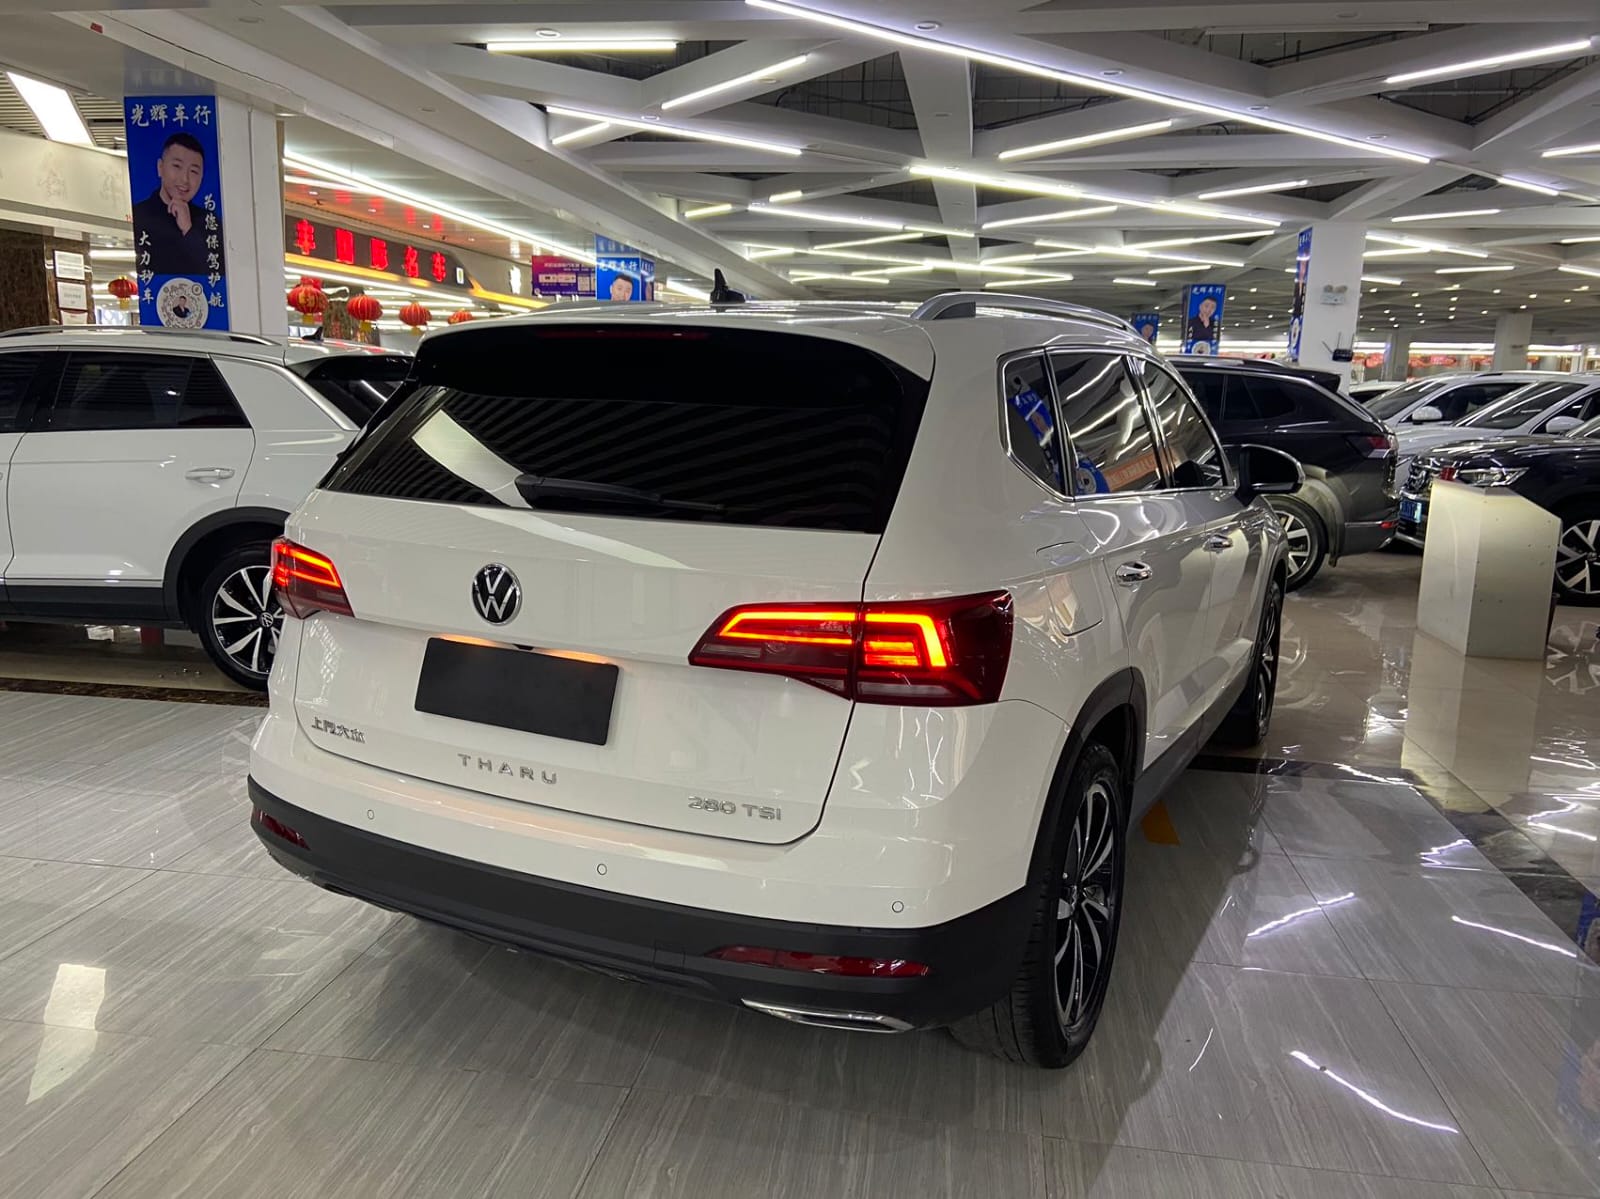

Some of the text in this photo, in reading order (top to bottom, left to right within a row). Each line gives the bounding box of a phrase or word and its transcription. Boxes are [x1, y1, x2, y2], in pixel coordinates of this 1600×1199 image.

[204, 193, 224, 307] 为您保驾护航
[473, 564, 521, 624] VW
[457, 753, 557, 785] THARU
[688, 796, 781, 821] 280 TSI
